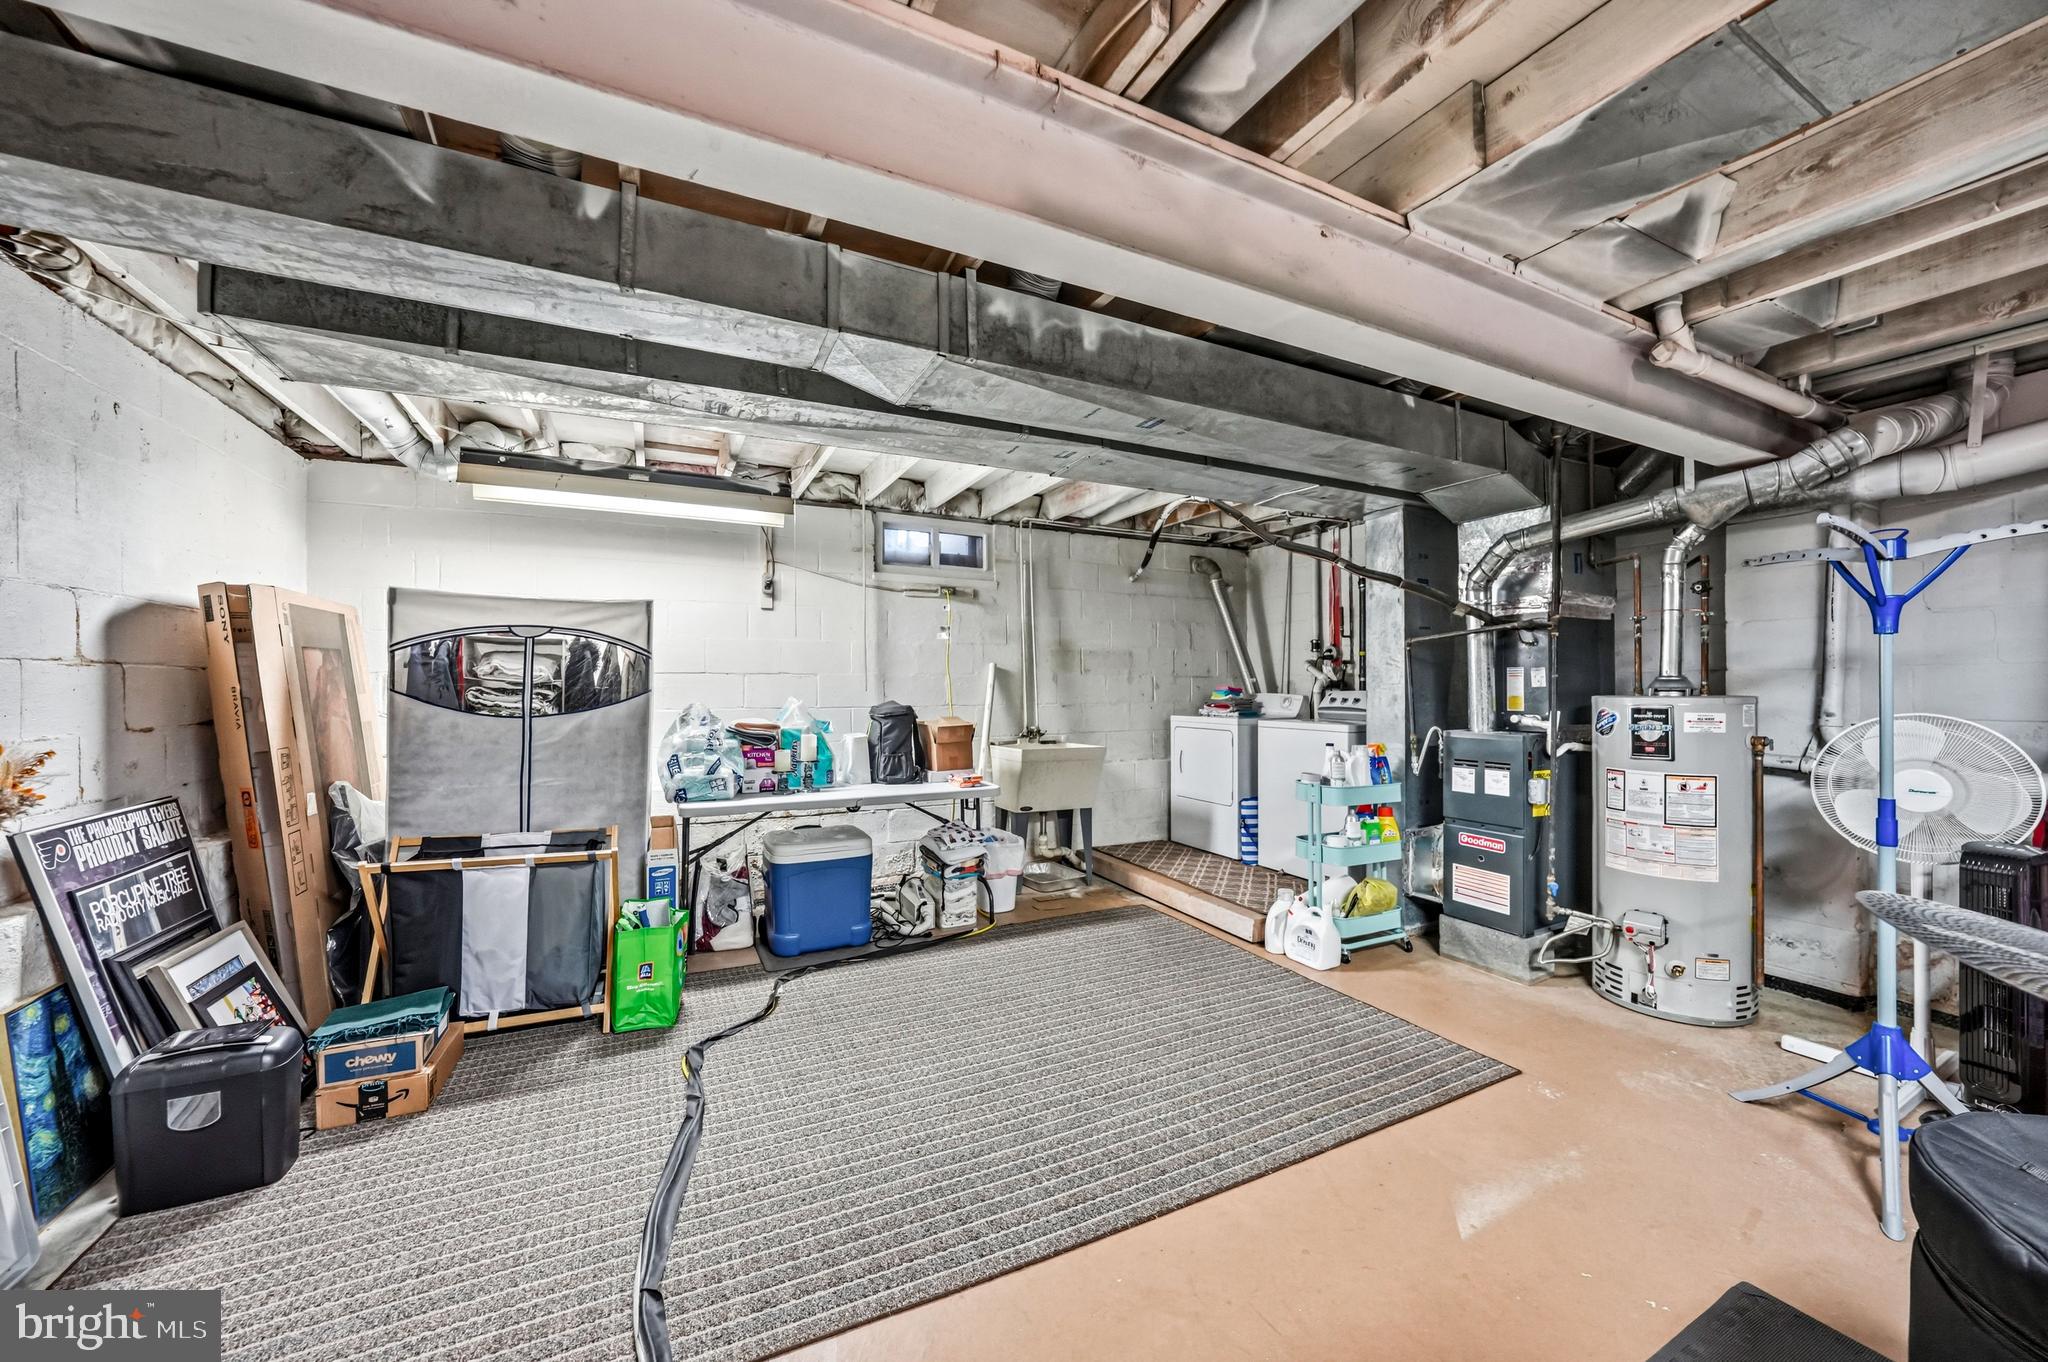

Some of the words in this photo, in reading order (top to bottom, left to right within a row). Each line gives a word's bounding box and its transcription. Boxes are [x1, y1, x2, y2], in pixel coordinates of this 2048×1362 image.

[217, 594, 230, 644] SONY
[231, 686, 242, 730] BRAVIA
[65, 827, 87, 847] THE
[86, 810, 150, 842] PHILADELPHIA
[149, 802, 180, 824] FLYERS
[72, 829, 140, 872] PROUDLY
[139, 816, 187, 850] SALUTE
[1460, 834, 1504, 850] Goodman
[89, 875, 161, 918] PORCUPINE
[159, 865, 188, 891] TREE
[95, 909, 127, 933] RADIO
[126, 899, 146, 919] CITY
[148, 888, 172, 909] MUSIC
[171, 878, 193, 900] HALL
[345, 1052, 397, 1068] chewy
